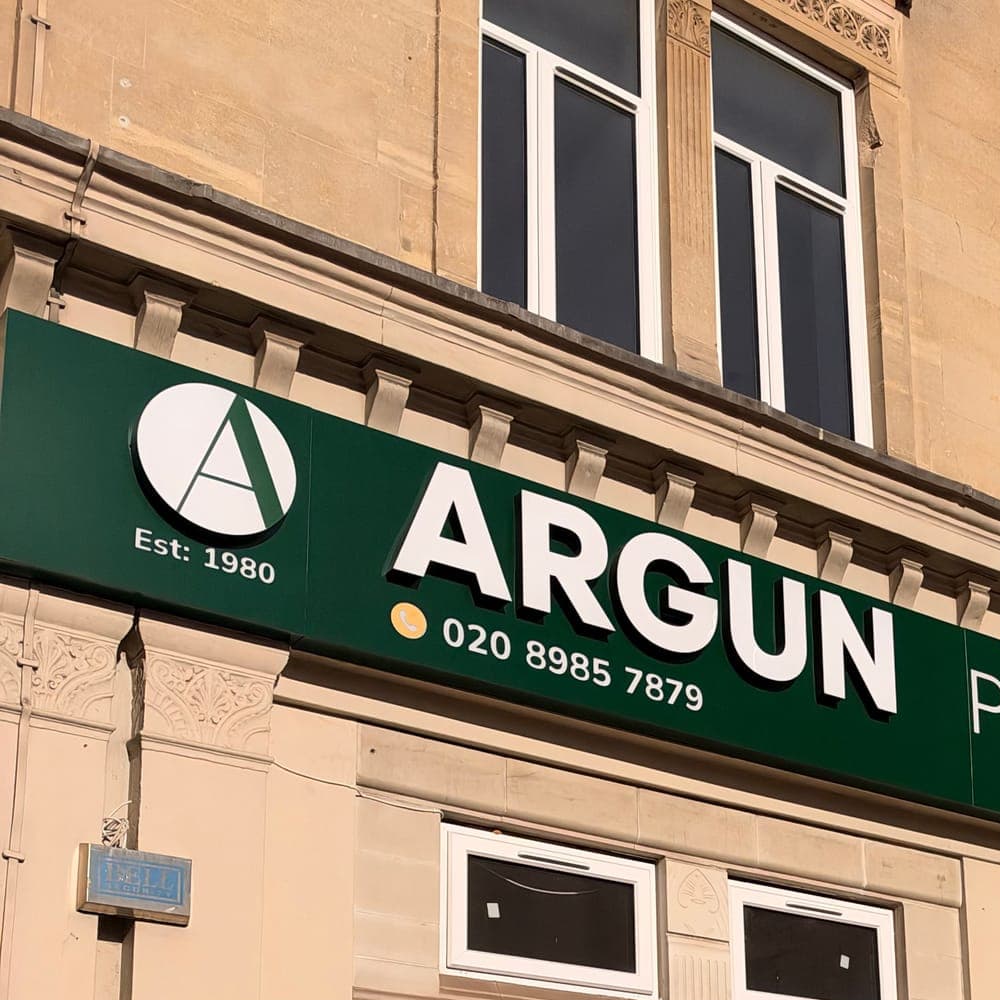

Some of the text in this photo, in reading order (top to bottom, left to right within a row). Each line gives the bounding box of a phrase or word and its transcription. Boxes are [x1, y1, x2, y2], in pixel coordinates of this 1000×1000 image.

[133, 526, 276, 585] Est: 1980
[390, 460, 898, 716] ARGUN
[442, 617, 704, 712] 020 8985 7879
